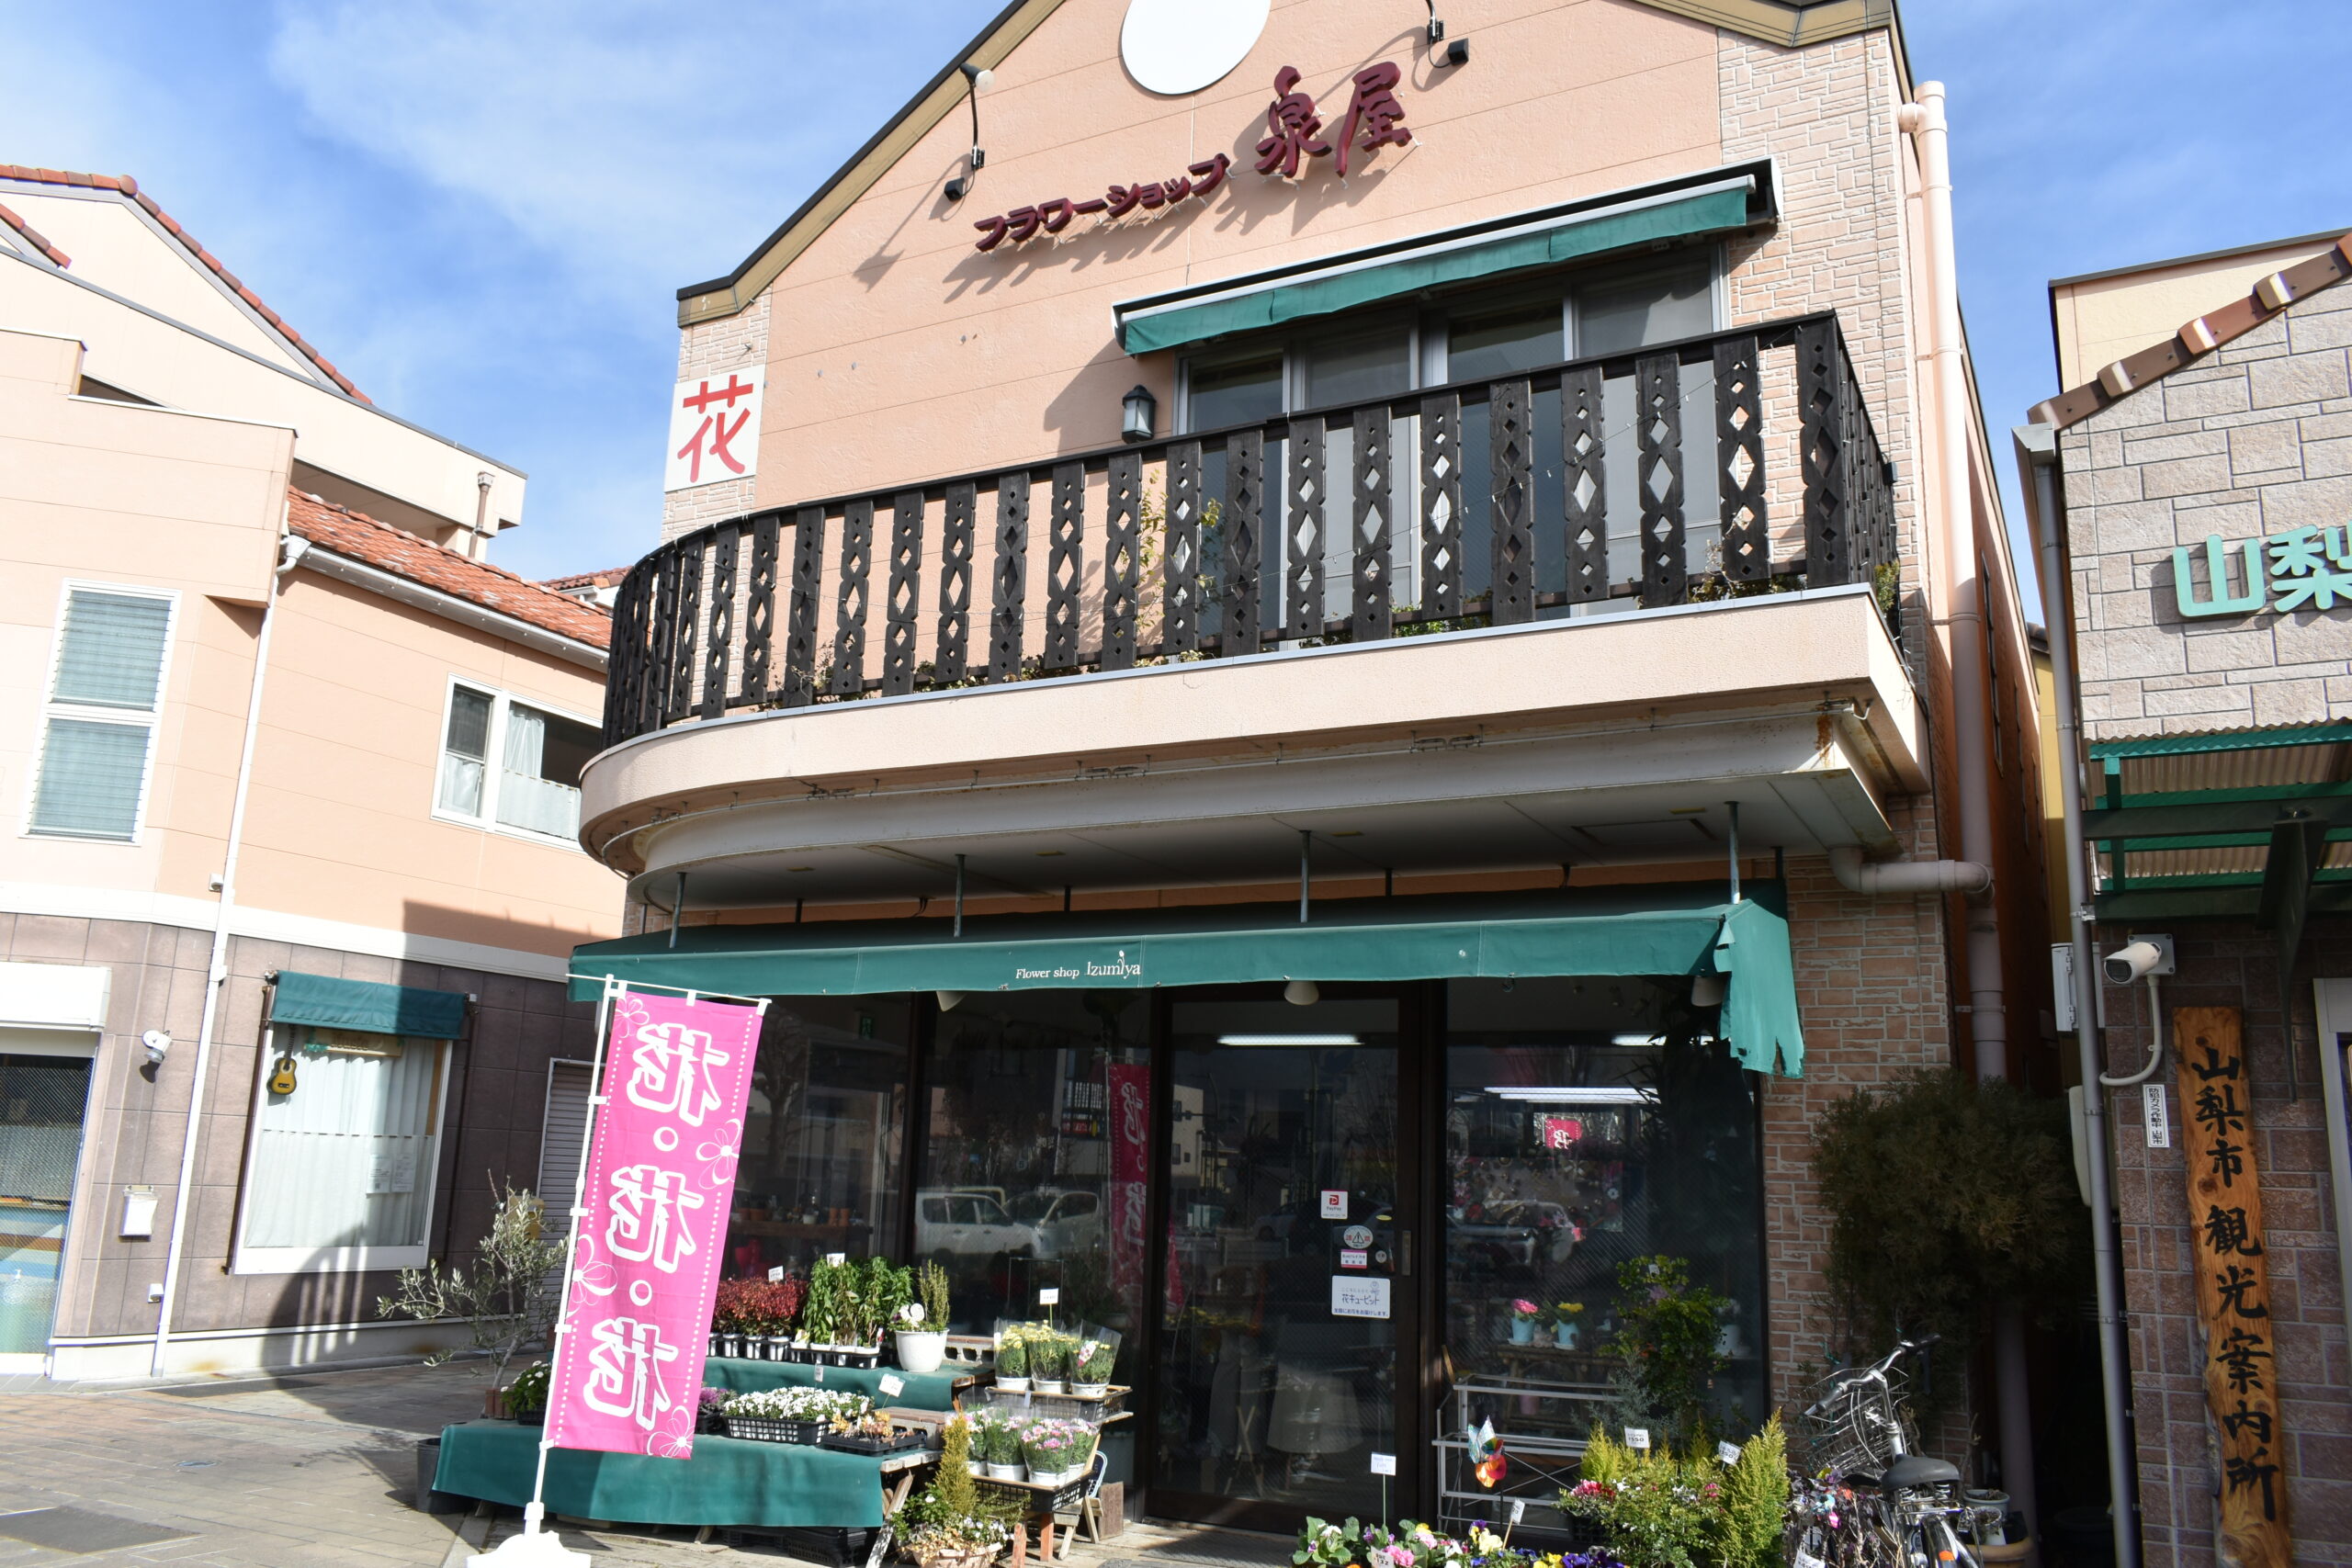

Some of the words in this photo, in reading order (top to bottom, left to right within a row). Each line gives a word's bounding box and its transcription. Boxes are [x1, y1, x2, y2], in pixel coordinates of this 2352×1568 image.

[974, 152, 1230, 252] フラワーショップ
[1254, 62, 1413, 178] 泉屋
[677, 375, 753, 483] 花
[2172, 521, 2352, 617] 山梨
[1015, 968, 1051, 979] Flower
[1053, 967, 1080, 979] shop
[1087, 950, 1141, 979] Izumiya
[1341, 1293, 1380, 1306] 花キューピット
[2191, 1046, 2279, 1523] 山梨市観光案内所
